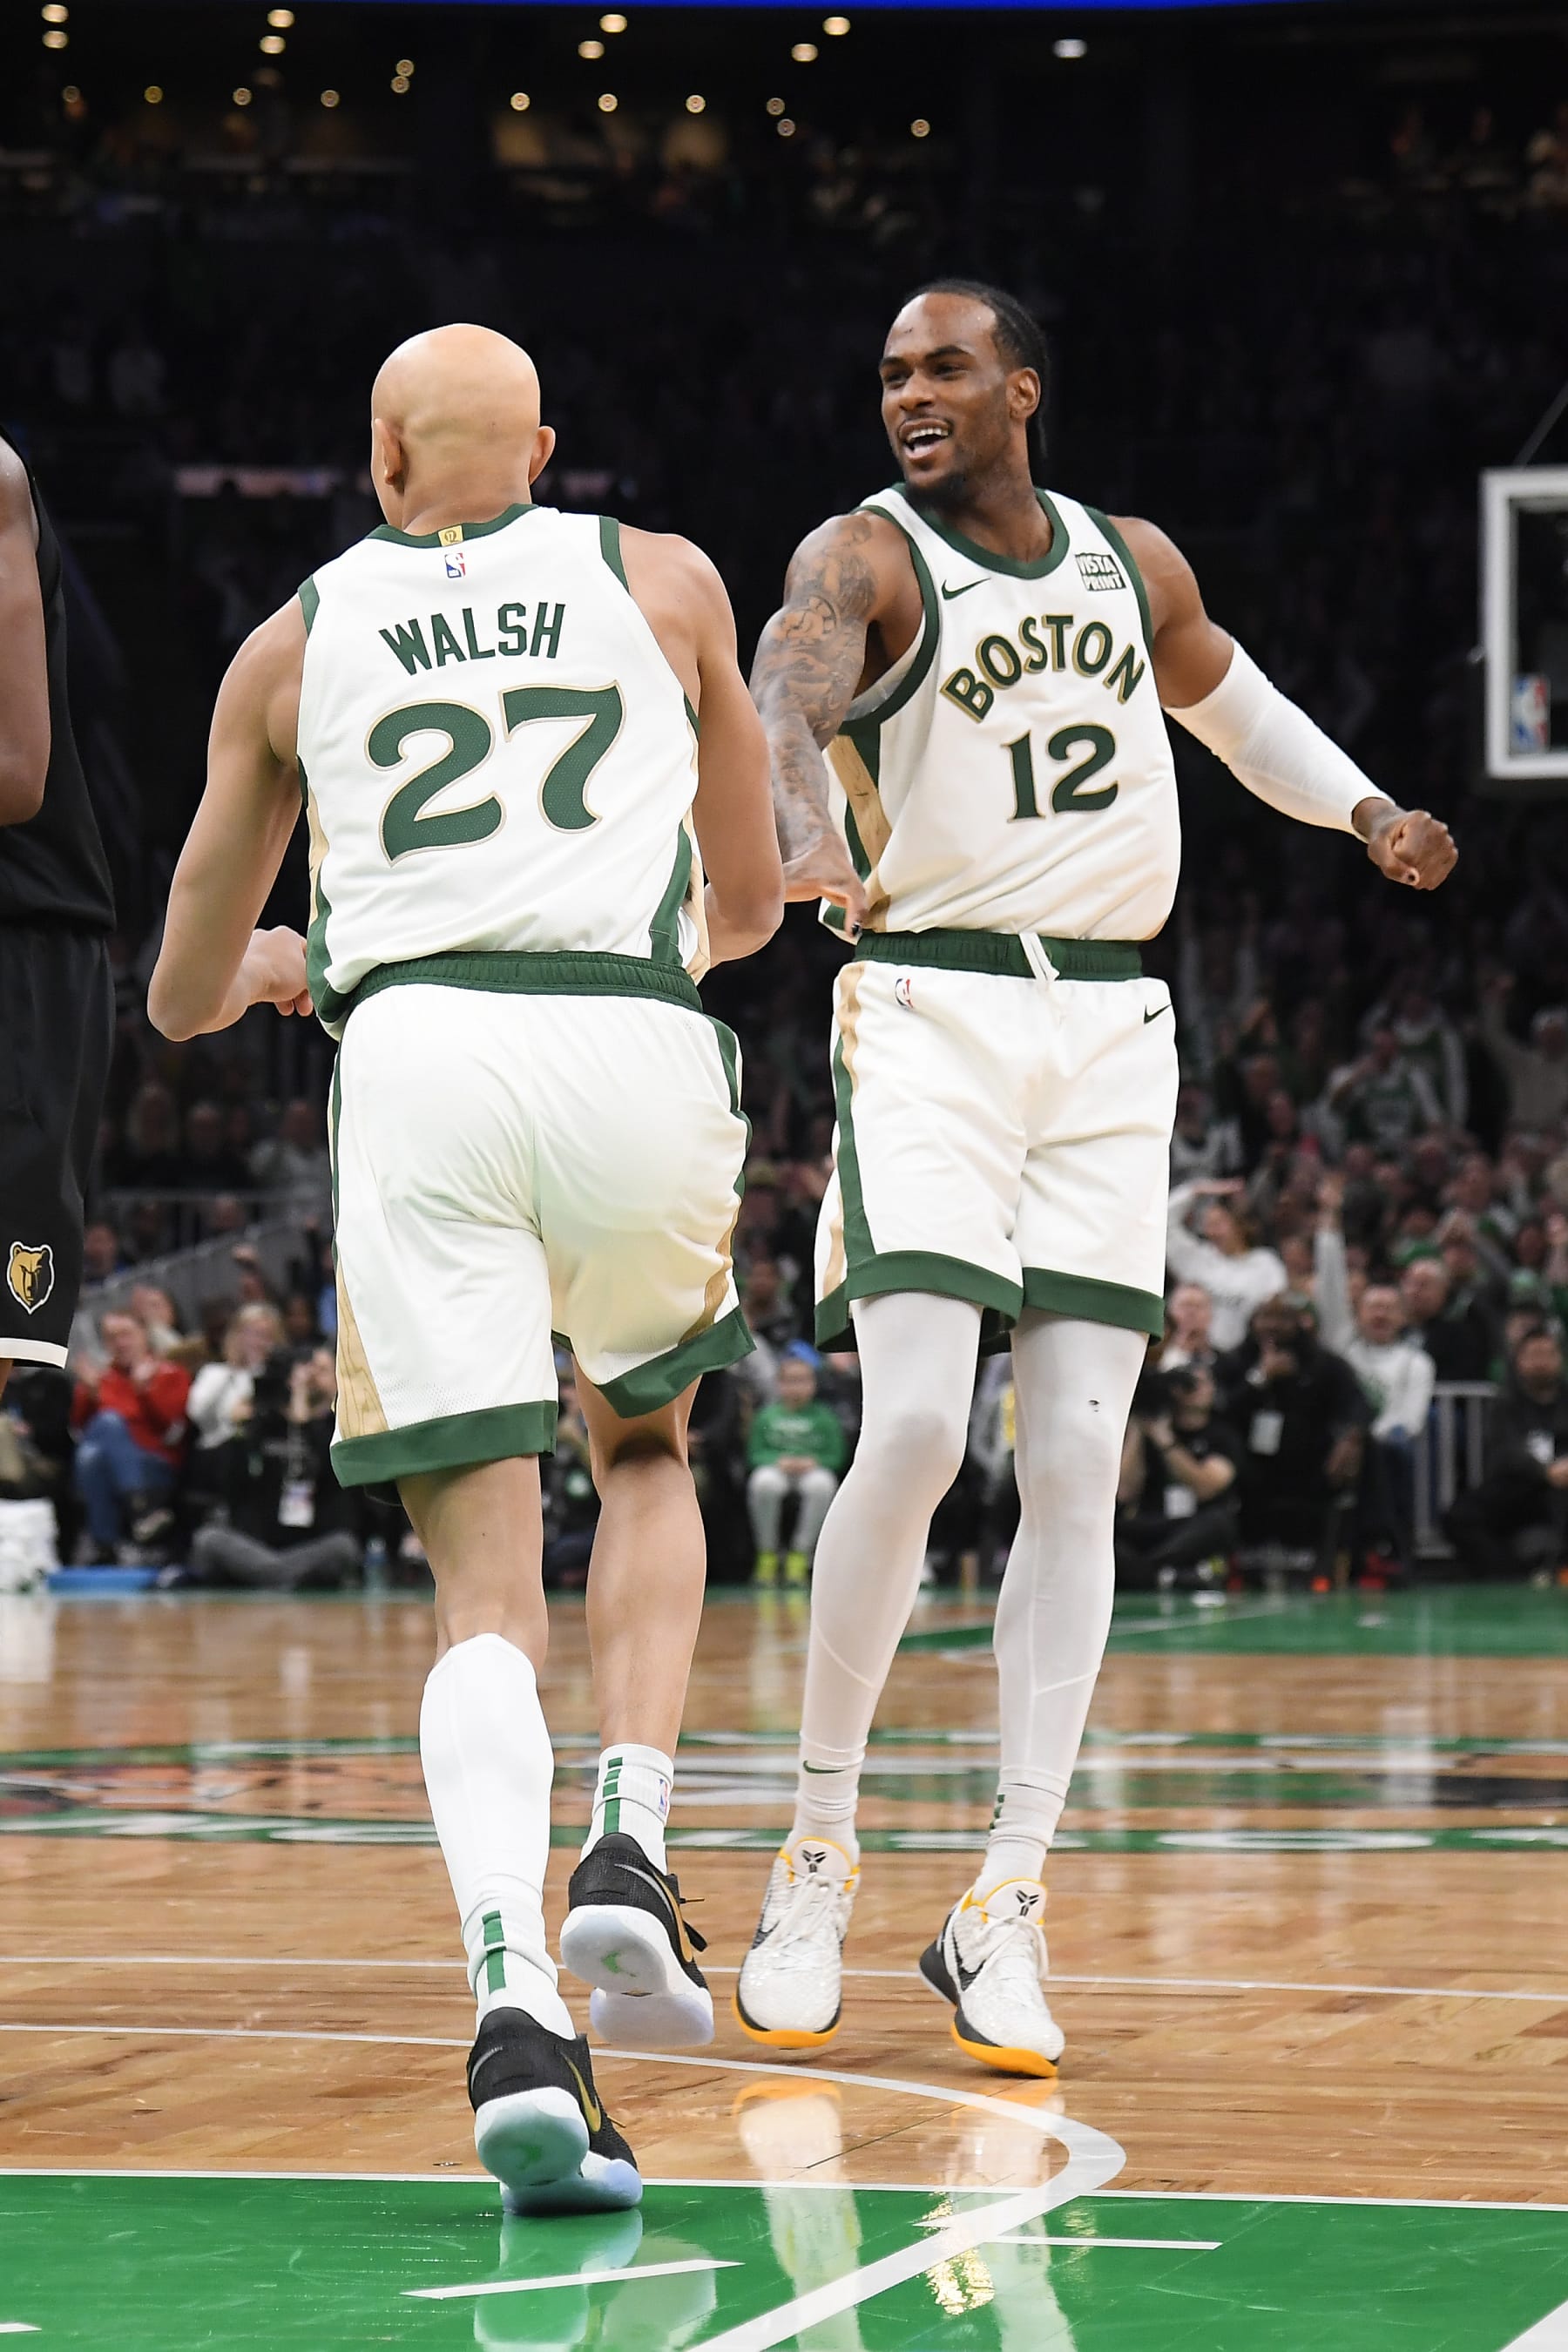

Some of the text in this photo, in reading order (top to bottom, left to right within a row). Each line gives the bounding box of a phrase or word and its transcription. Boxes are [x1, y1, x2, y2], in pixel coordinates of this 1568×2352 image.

[1076, 555, 1118, 575] VISTA
[1084, 574, 1123, 591] PRINT
[378, 602, 565, 675] WALSH
[940, 614, 1146, 724] BOSTON
[364, 679, 626, 868] 27
[1000, 722, 1119, 822] 12
